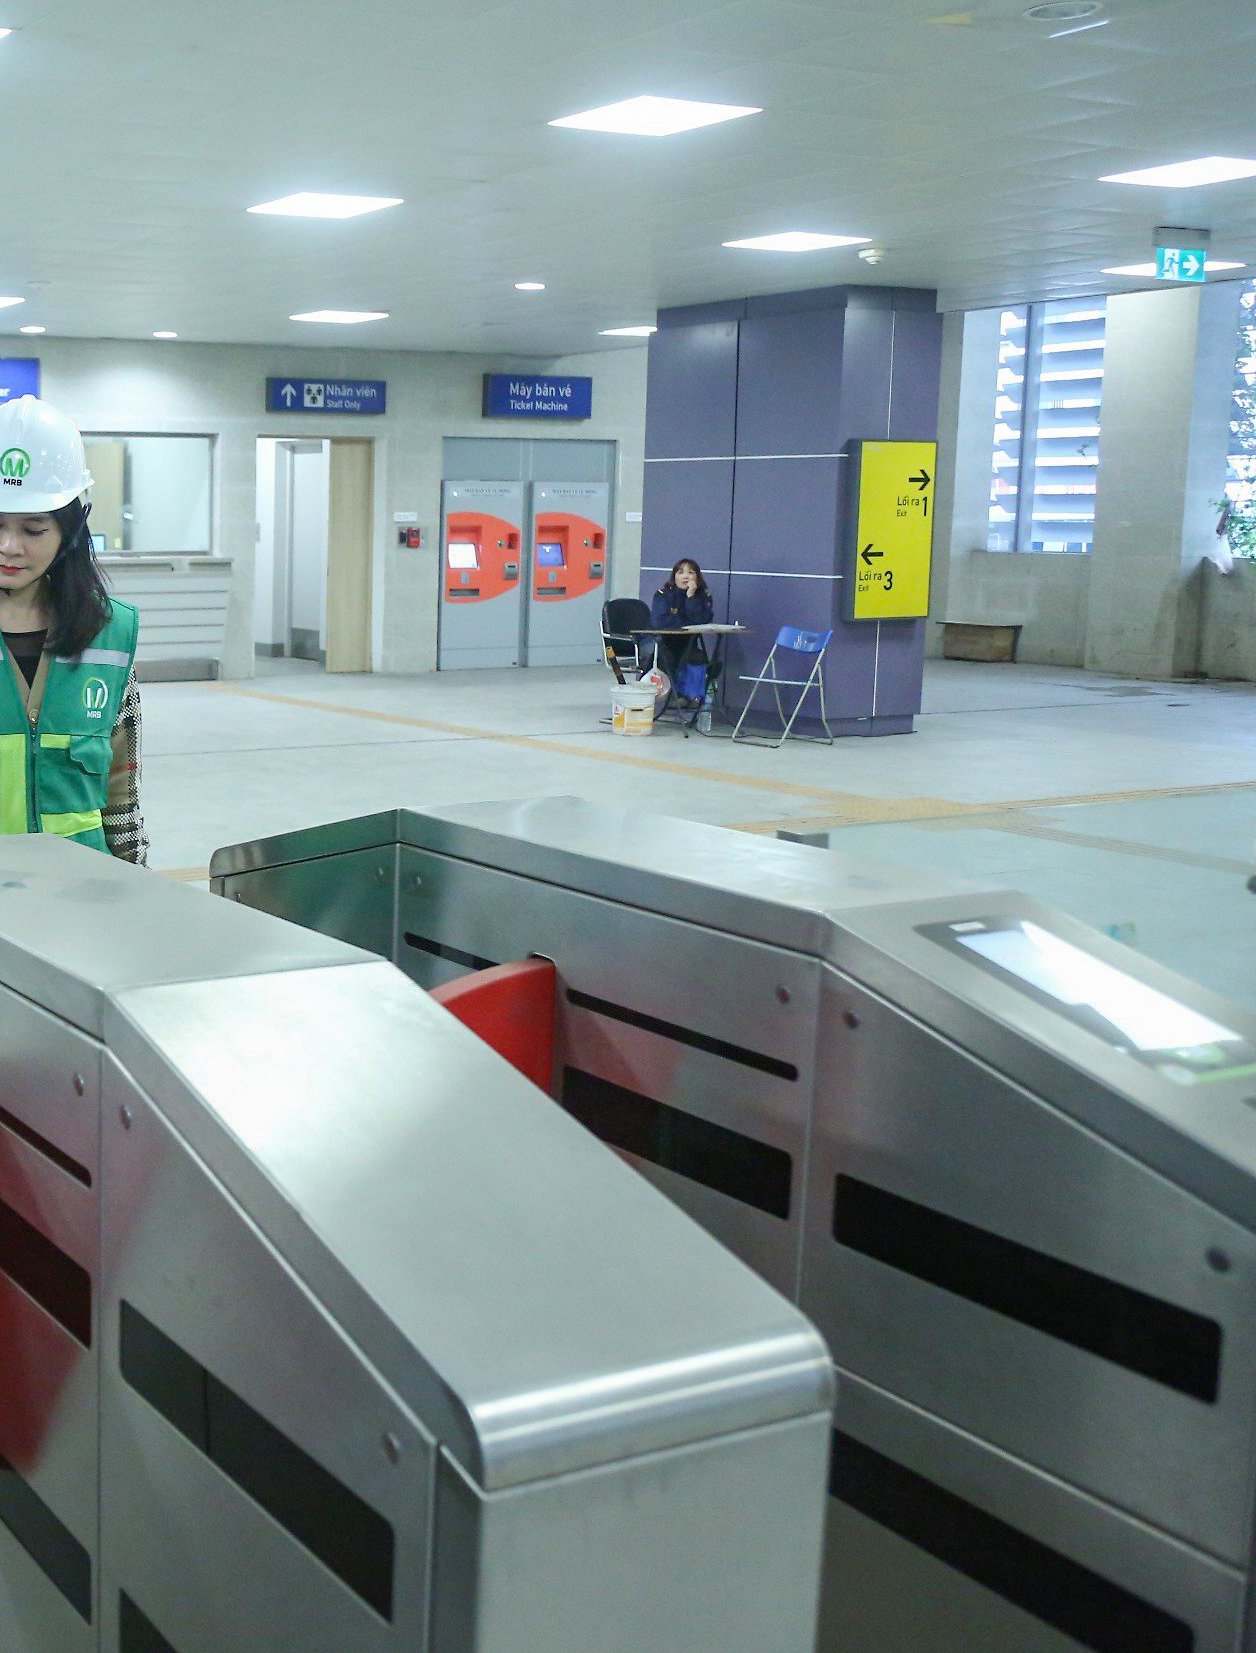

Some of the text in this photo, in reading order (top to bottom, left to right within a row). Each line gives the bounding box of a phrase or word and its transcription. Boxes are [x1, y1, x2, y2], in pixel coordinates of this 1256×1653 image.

[325, 384, 377, 398] Nhân viên
[509, 381, 572, 399] Máy bán vé
[326, 399, 361, 411] Staff Only
[509, 400, 568, 412] Ticket Machine
[3, 478, 23, 486] MRB
[897, 495, 909, 506] Lối
[922, 496, 928, 517] 1
[896, 509, 907, 517] Exit
[858, 570, 893, 591] Lối ra 3
[858, 584, 869, 592] Exit
[86, 710, 102, 719] MRB
